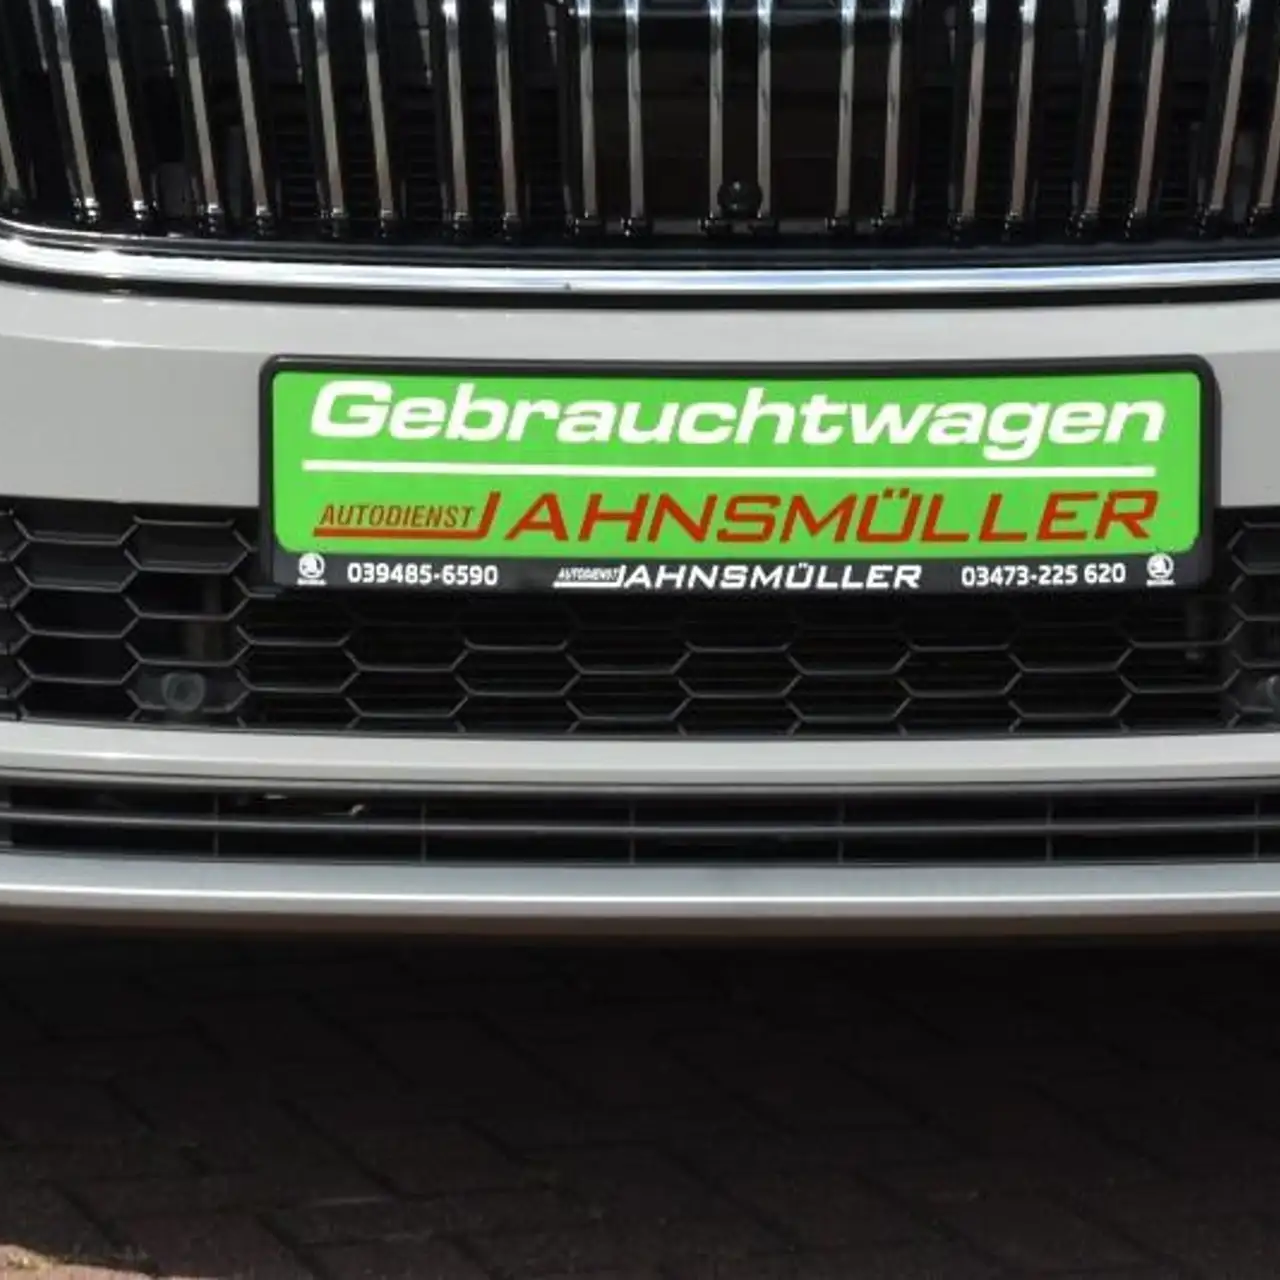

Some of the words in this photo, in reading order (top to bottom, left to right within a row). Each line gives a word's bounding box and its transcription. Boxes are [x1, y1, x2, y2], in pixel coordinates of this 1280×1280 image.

[310, 381, 1165, 460] Gebrauchtwagen
[320, 503, 476, 529] AUTODIENST
[465, 487, 1158, 544] JAHNSMÜLLER
[347, 562, 499, 586] 039485-6590
[613, 562, 922, 589] JAHNSMÜLLER
[961, 564, 1078, 588] 03473-225
[1084, 562, 1127, 584] 620
